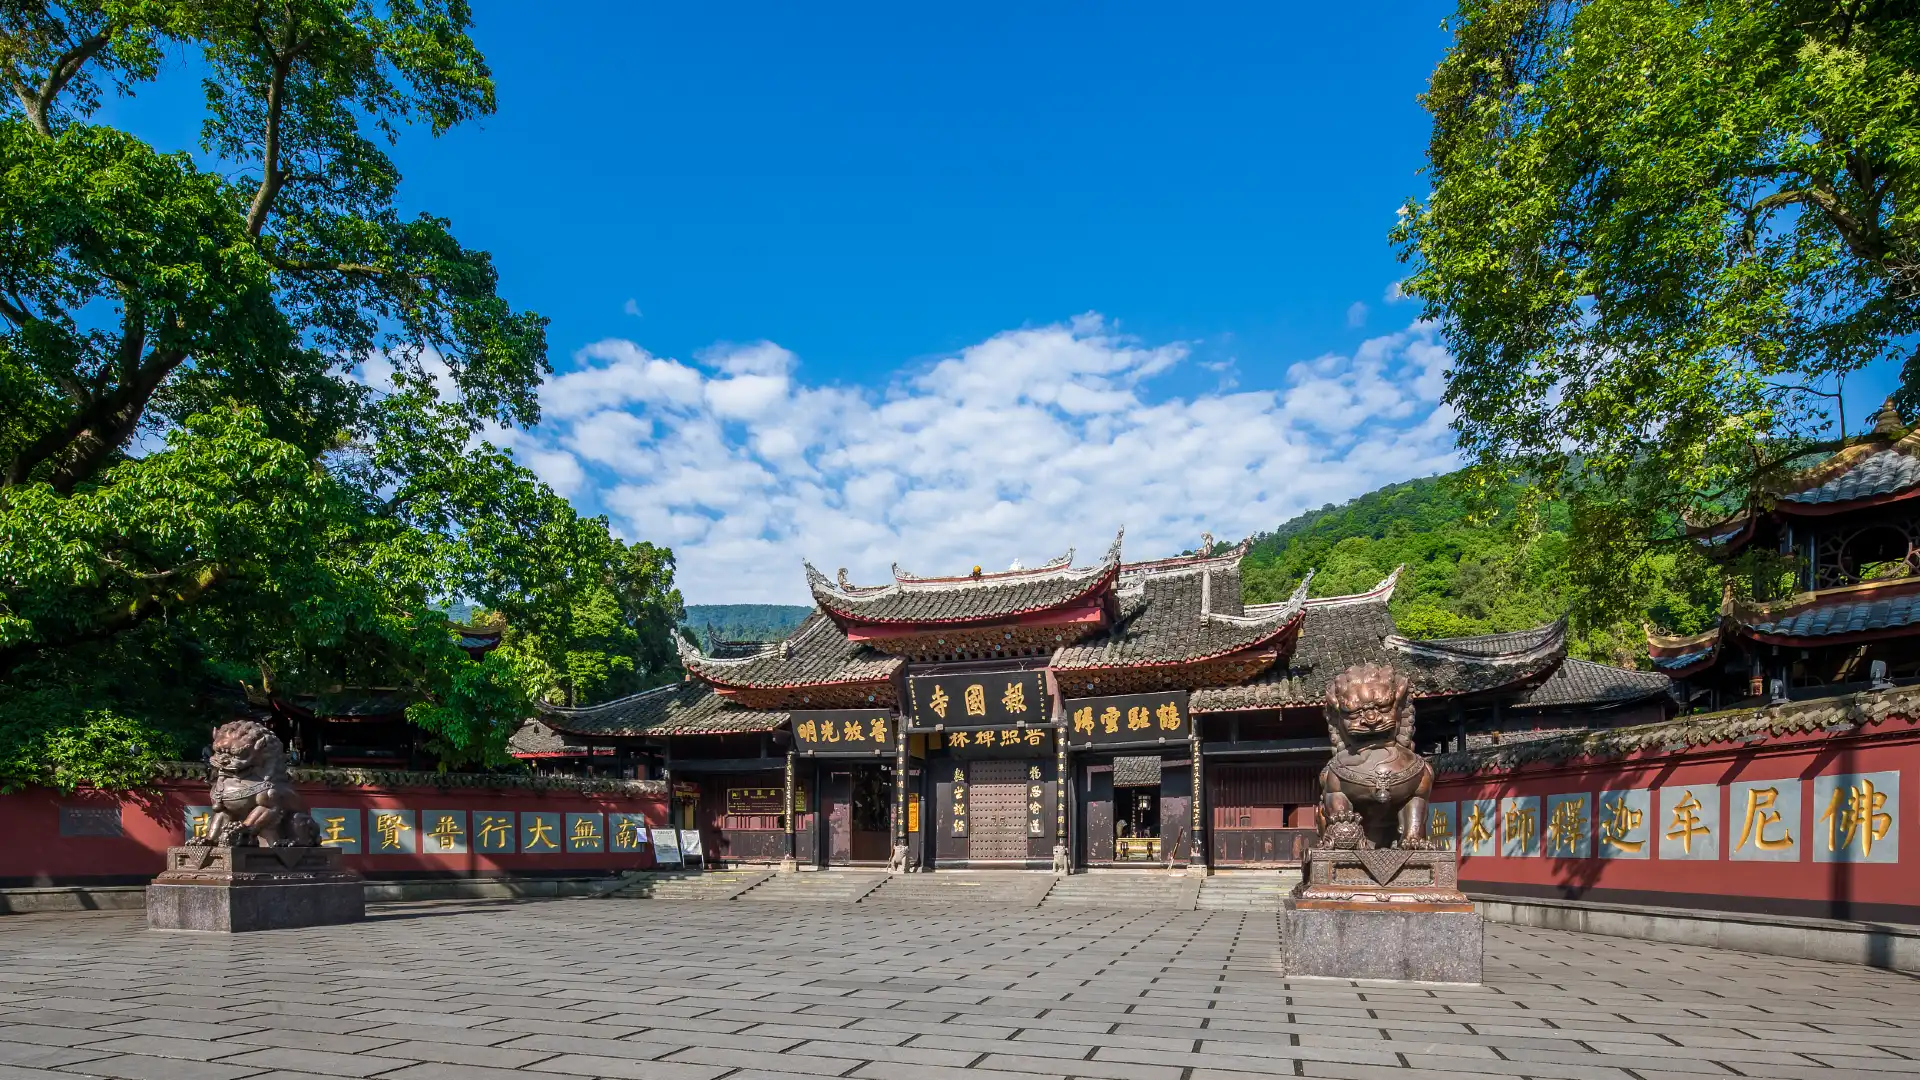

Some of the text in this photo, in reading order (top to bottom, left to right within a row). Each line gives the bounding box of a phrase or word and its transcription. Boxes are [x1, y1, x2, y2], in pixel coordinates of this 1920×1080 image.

[930, 682, 1027, 718] 報國寺
[797, 718, 888, 743] 普放光明
[948, 728, 1045, 747] 普照禪林
[193, 811, 638, 850] 南無大行普賢王
